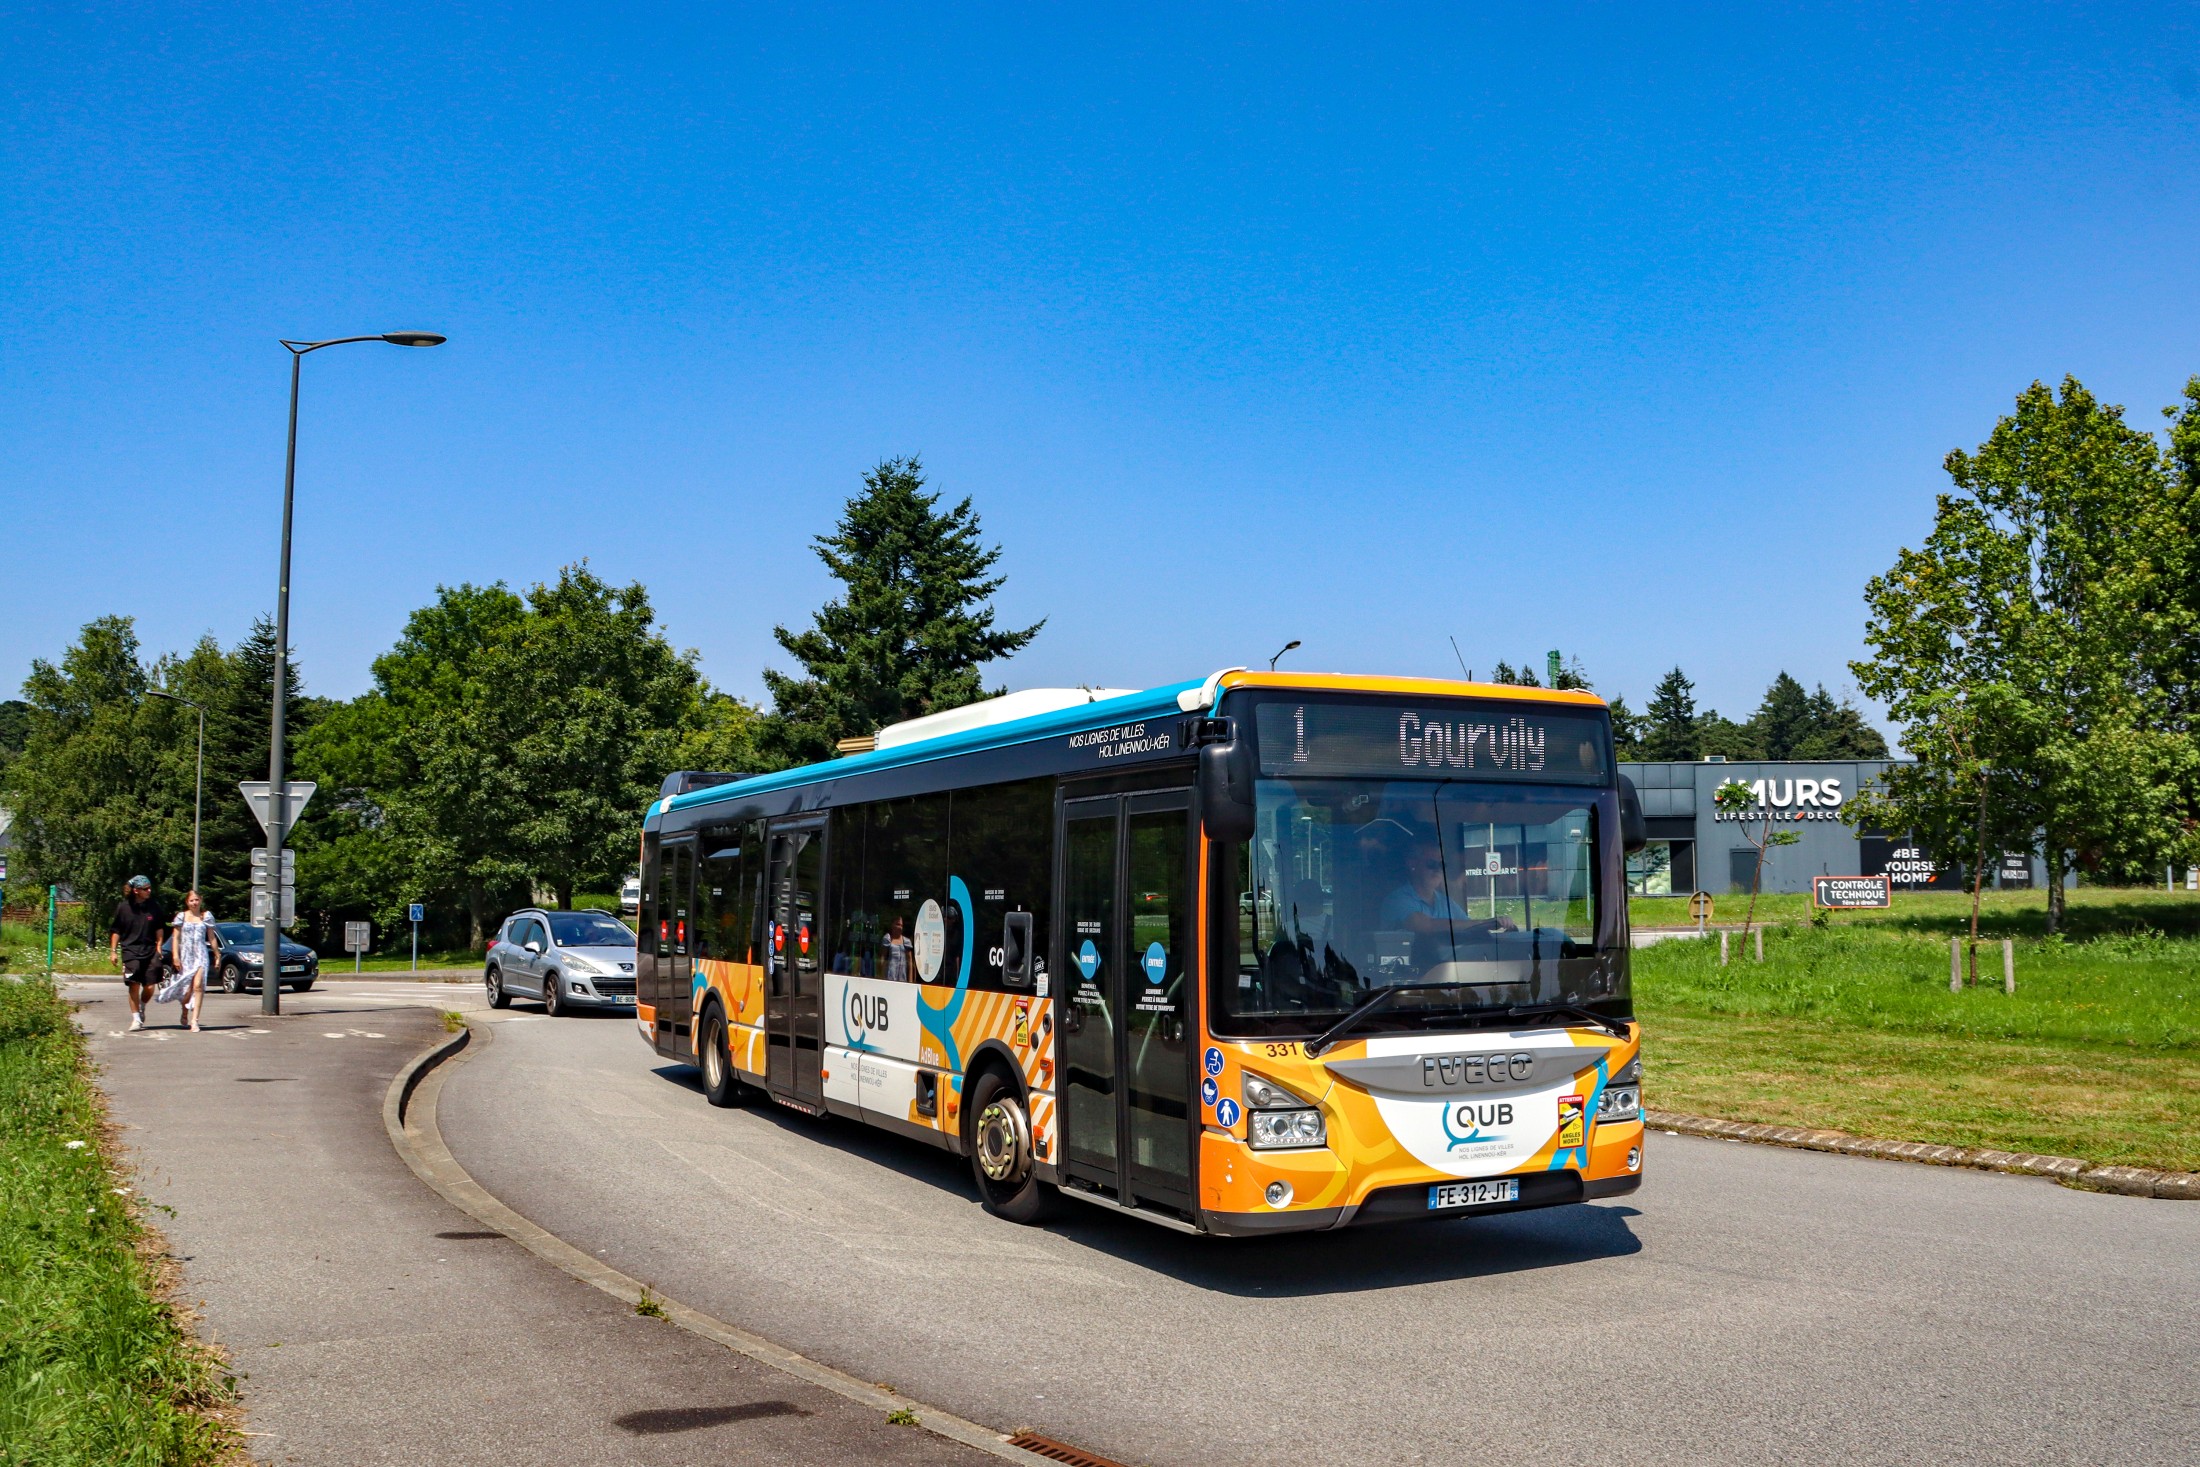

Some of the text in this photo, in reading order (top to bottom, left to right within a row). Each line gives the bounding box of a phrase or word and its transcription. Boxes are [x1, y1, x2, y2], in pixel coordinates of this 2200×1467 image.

[1069, 723, 1145, 749] NOS LIGNES DE VILLES
[1294, 706, 1545, 771] 1 Gourvily
[1098, 744, 1114, 759] HOL
[1715, 812, 1791, 820] LIFESTYLE
[1892, 848, 1920, 859] #BE
[1465, 868, 1482, 876] NTRÉE
[1885, 861, 1950, 872] YOURSE
[1831, 879, 1883, 890] CONTRÔLE
[1831, 890, 1886, 900] TECHNIQUE
[989, 947, 1004, 967] GO
[1081, 955, 1095, 964] ENTRÉE
[1147, 957, 1164, 968] ENTRÉE
[851, 992, 889, 1032] QUB
[920, 1046, 939, 1066] AdBlue
[1265, 1044, 1297, 1058] 331
[1423, 1052, 1534, 1087] IVECO
[1456, 1103, 1514, 1129] QUB
[1562, 1137, 1580, 1145] MORTS
